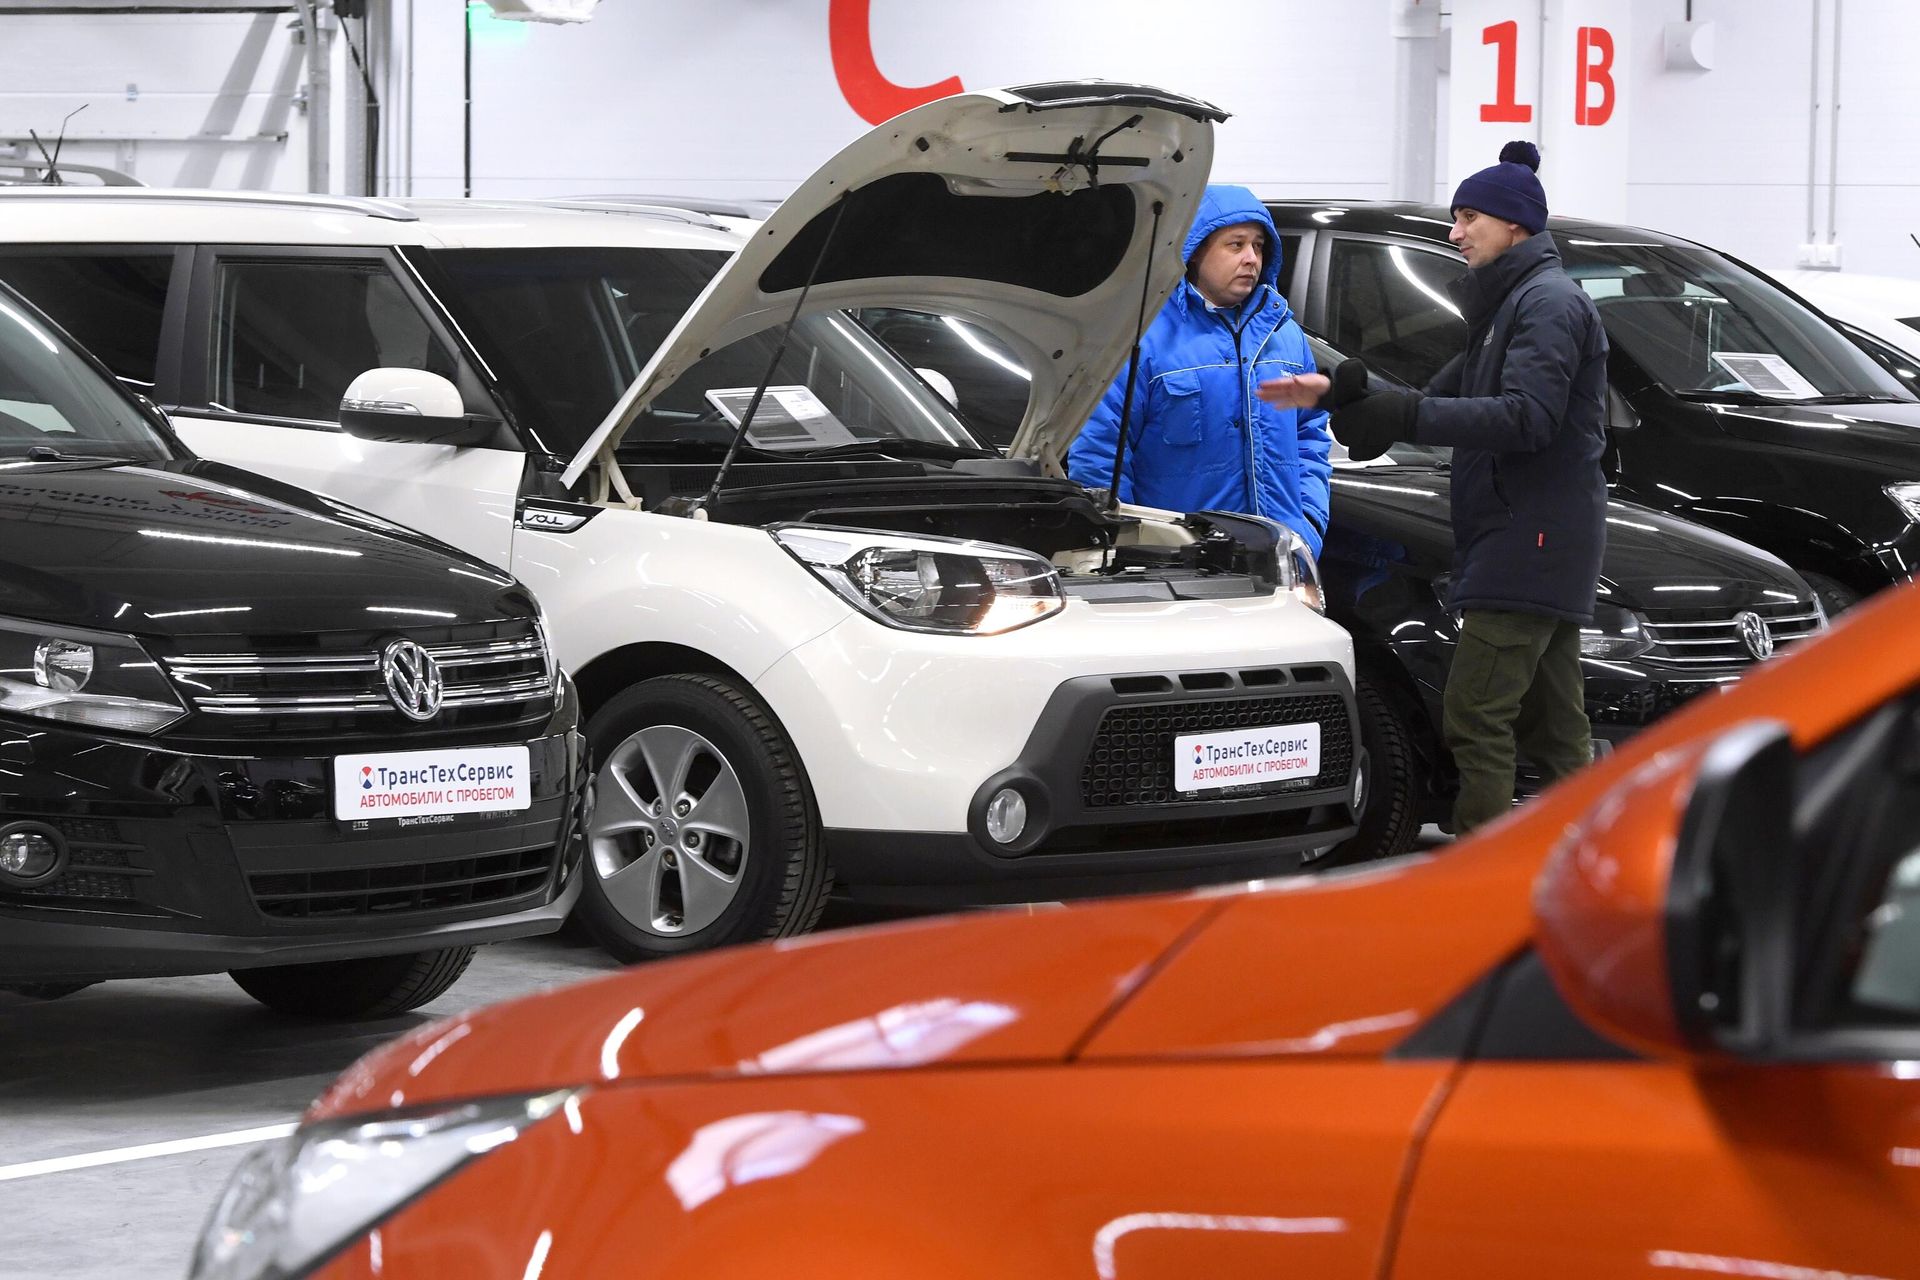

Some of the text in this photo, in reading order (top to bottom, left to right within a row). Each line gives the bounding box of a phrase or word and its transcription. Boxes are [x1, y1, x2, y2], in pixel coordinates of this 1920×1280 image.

[1480, 20, 1532, 122] 1
[1206, 737, 1308, 764] ТрансТехСервис
[378, 763, 514, 790] ТрансТехСервис
[1192, 762, 1254, 781] АВТОМОБИЛИ
[1264, 757, 1308, 773] ПРОБЕГОМ
[360, 789, 443, 808] АВТОМОБИЛИ
[457, 786, 515, 803] ПРОБЕГОМ
